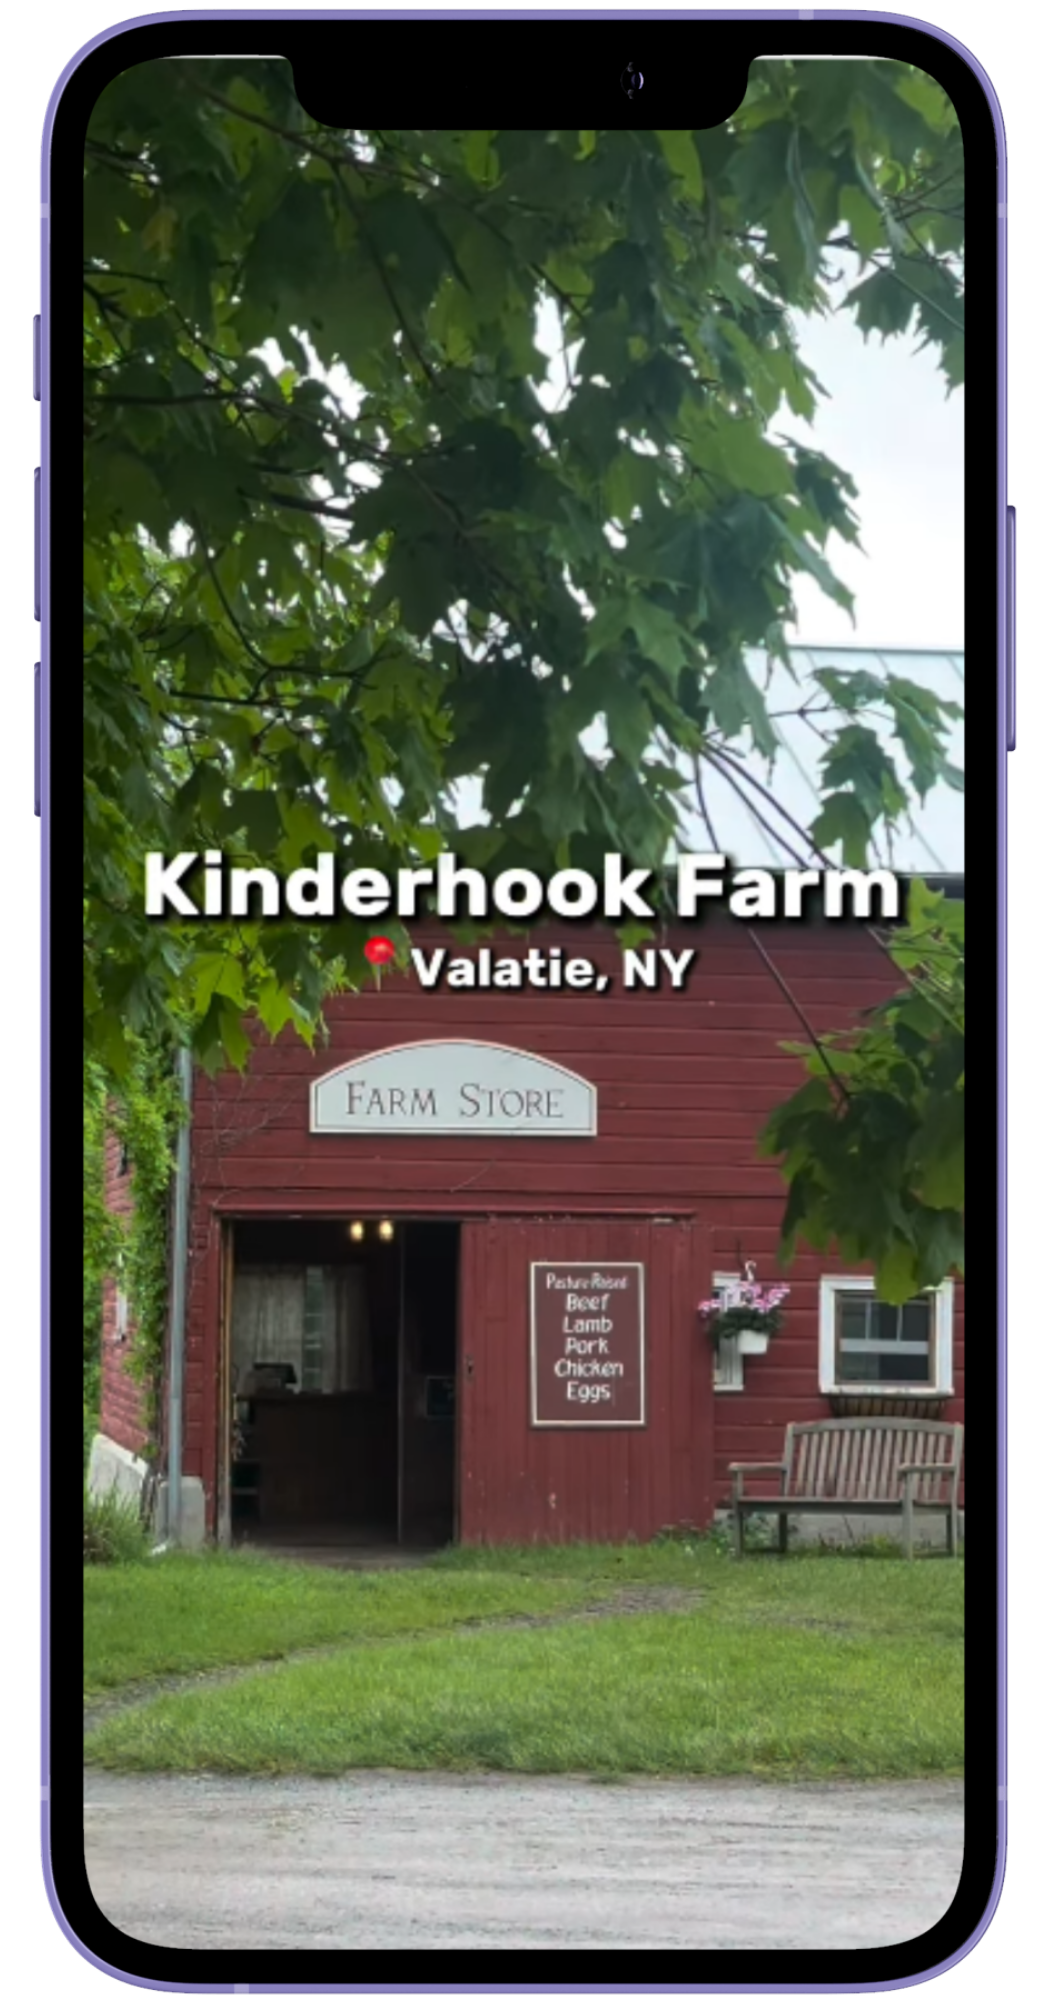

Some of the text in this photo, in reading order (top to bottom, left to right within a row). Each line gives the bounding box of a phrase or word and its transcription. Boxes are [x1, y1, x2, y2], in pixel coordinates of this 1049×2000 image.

[346, 1081, 565, 1118] FARM STORE
[566, 1293, 610, 1312] Beef
[563, 1315, 613, 1333] Lamb
[565, 1337, 609, 1355] Pork
[554, 1358, 624, 1378] Chicken
[566, 1380, 611, 1403] Eggs
